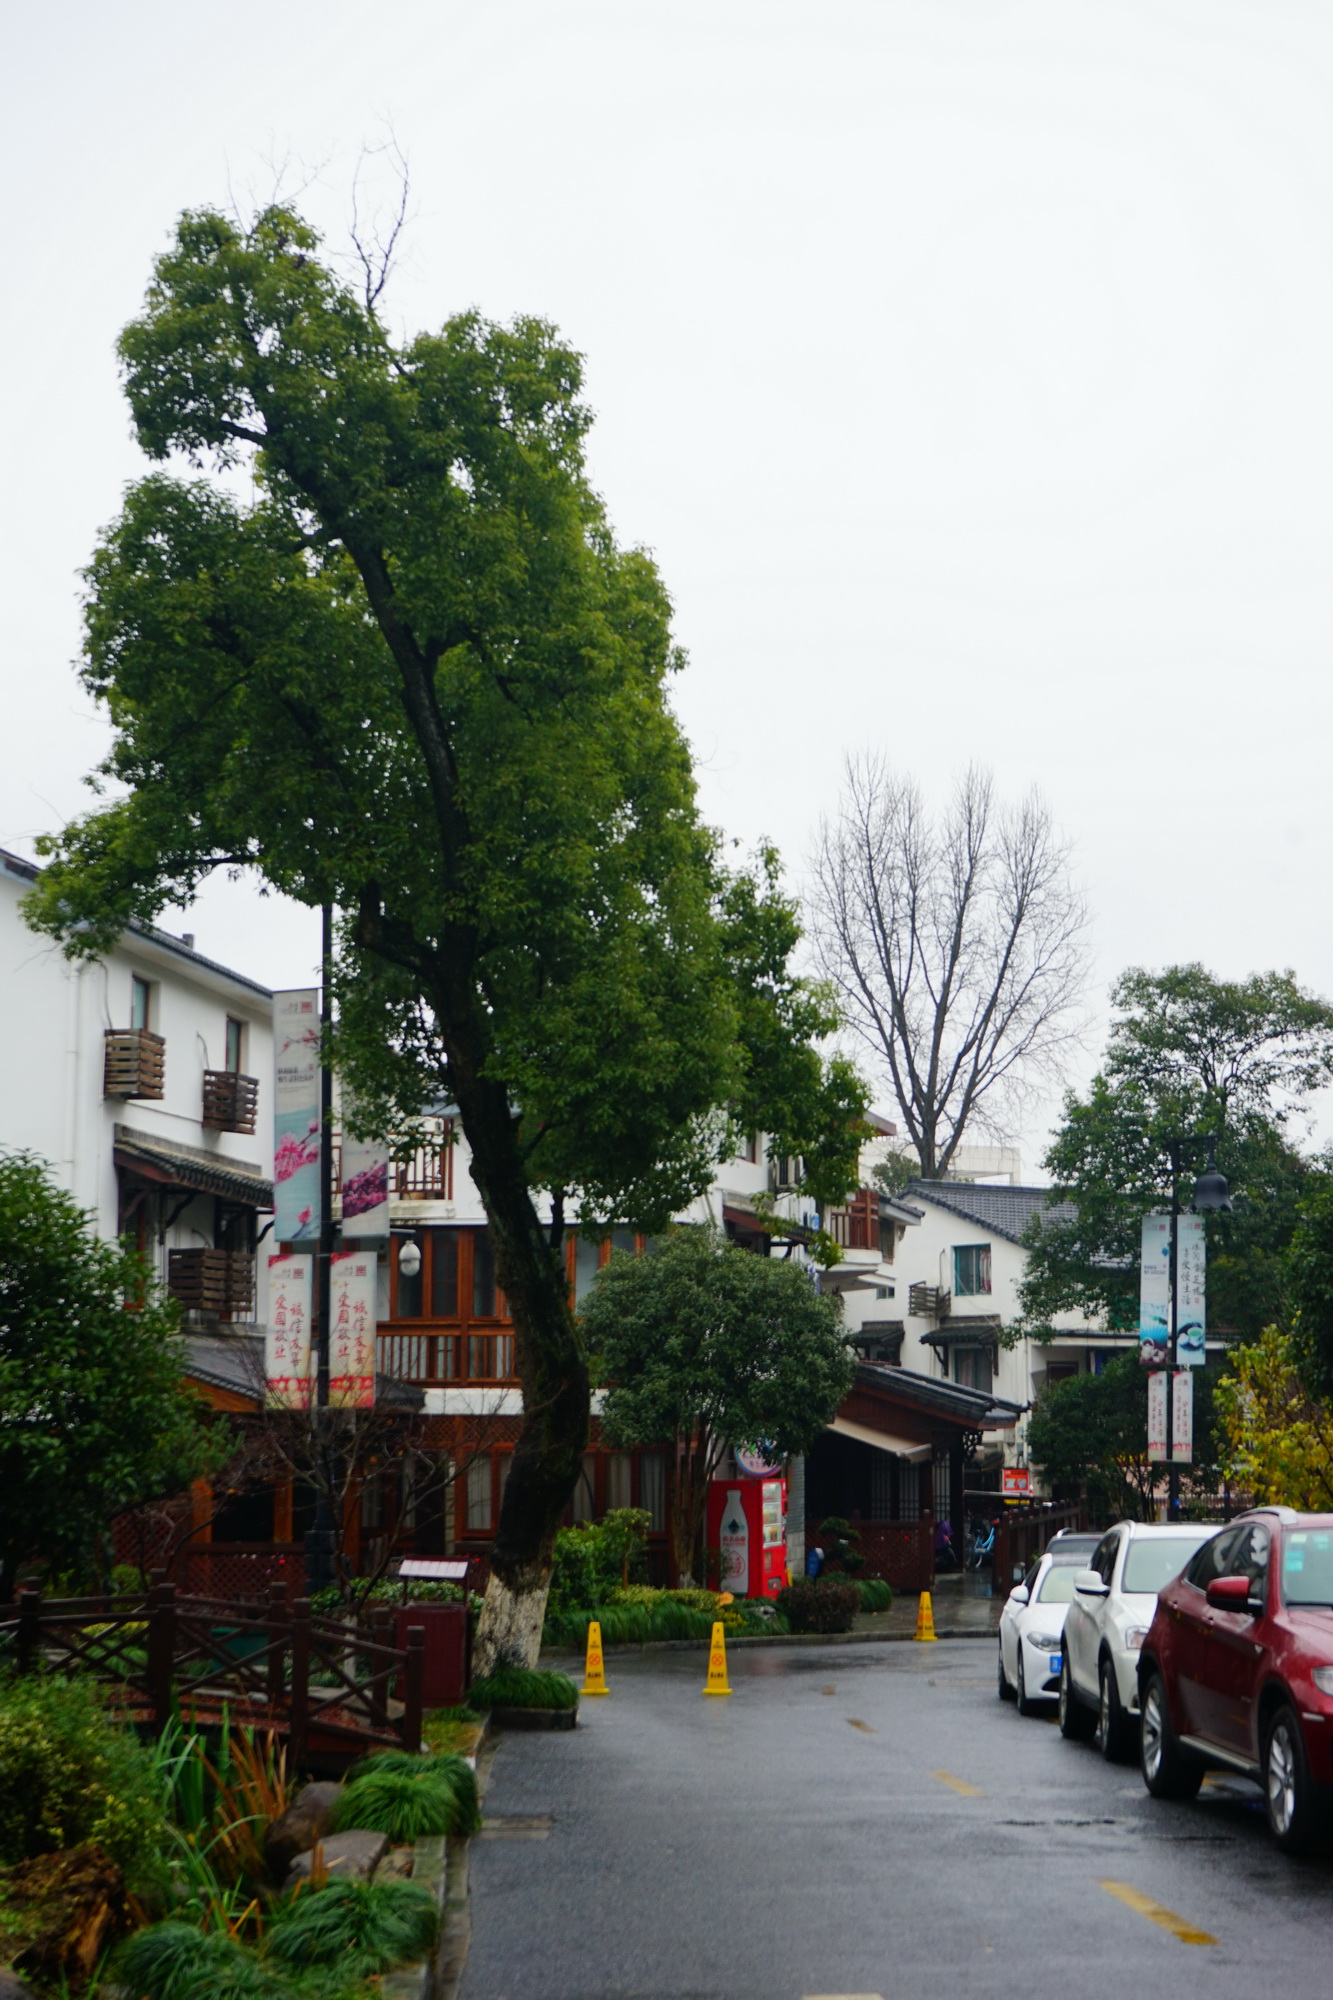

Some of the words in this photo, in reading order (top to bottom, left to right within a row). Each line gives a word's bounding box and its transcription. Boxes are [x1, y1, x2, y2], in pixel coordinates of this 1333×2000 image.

[274, 1294, 288, 1359] 爱国敬业
[290, 1303, 304, 1366] 诚信友善
[337, 1291, 351, 1358] 爱国敬业
[353, 1300, 368, 1365] 诚信友善
